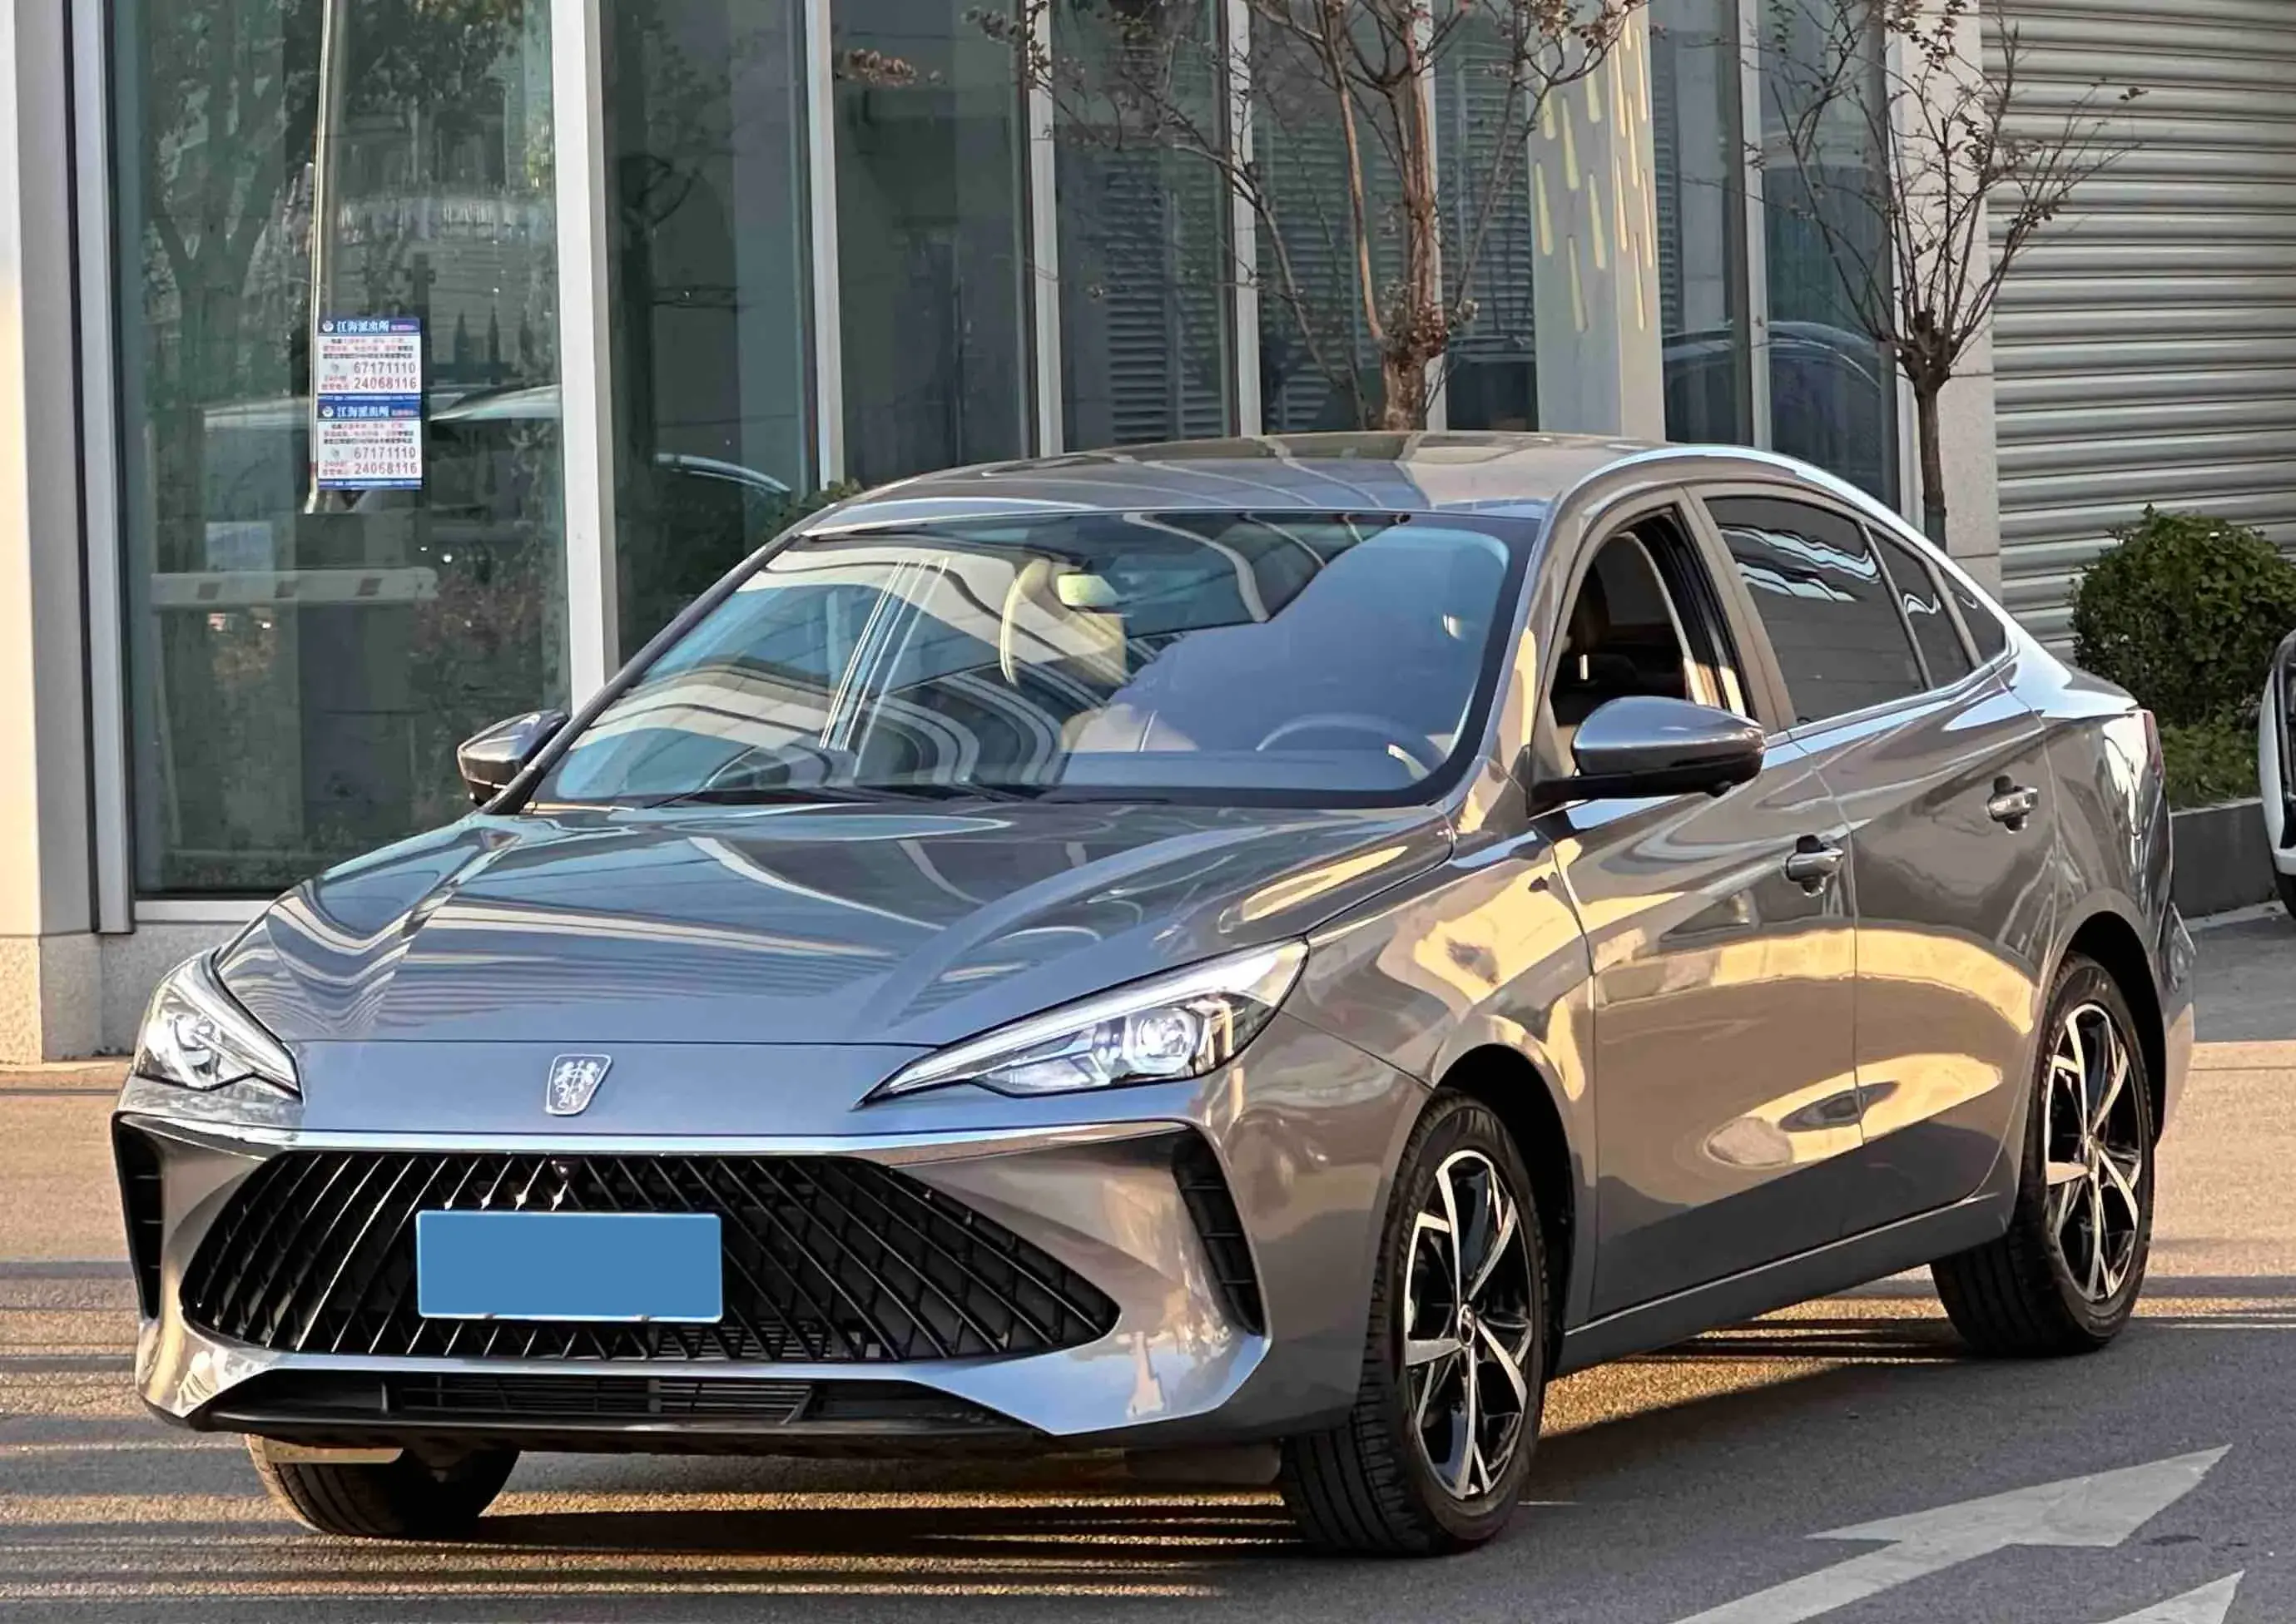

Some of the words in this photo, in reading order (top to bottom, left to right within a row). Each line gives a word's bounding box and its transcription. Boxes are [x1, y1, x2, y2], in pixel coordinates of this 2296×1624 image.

[354, 361, 416, 374] 67171110
[354, 377, 418, 389] 24068116
[354, 447, 416, 460] 67171110
[355, 463, 418, 475] 24068116
